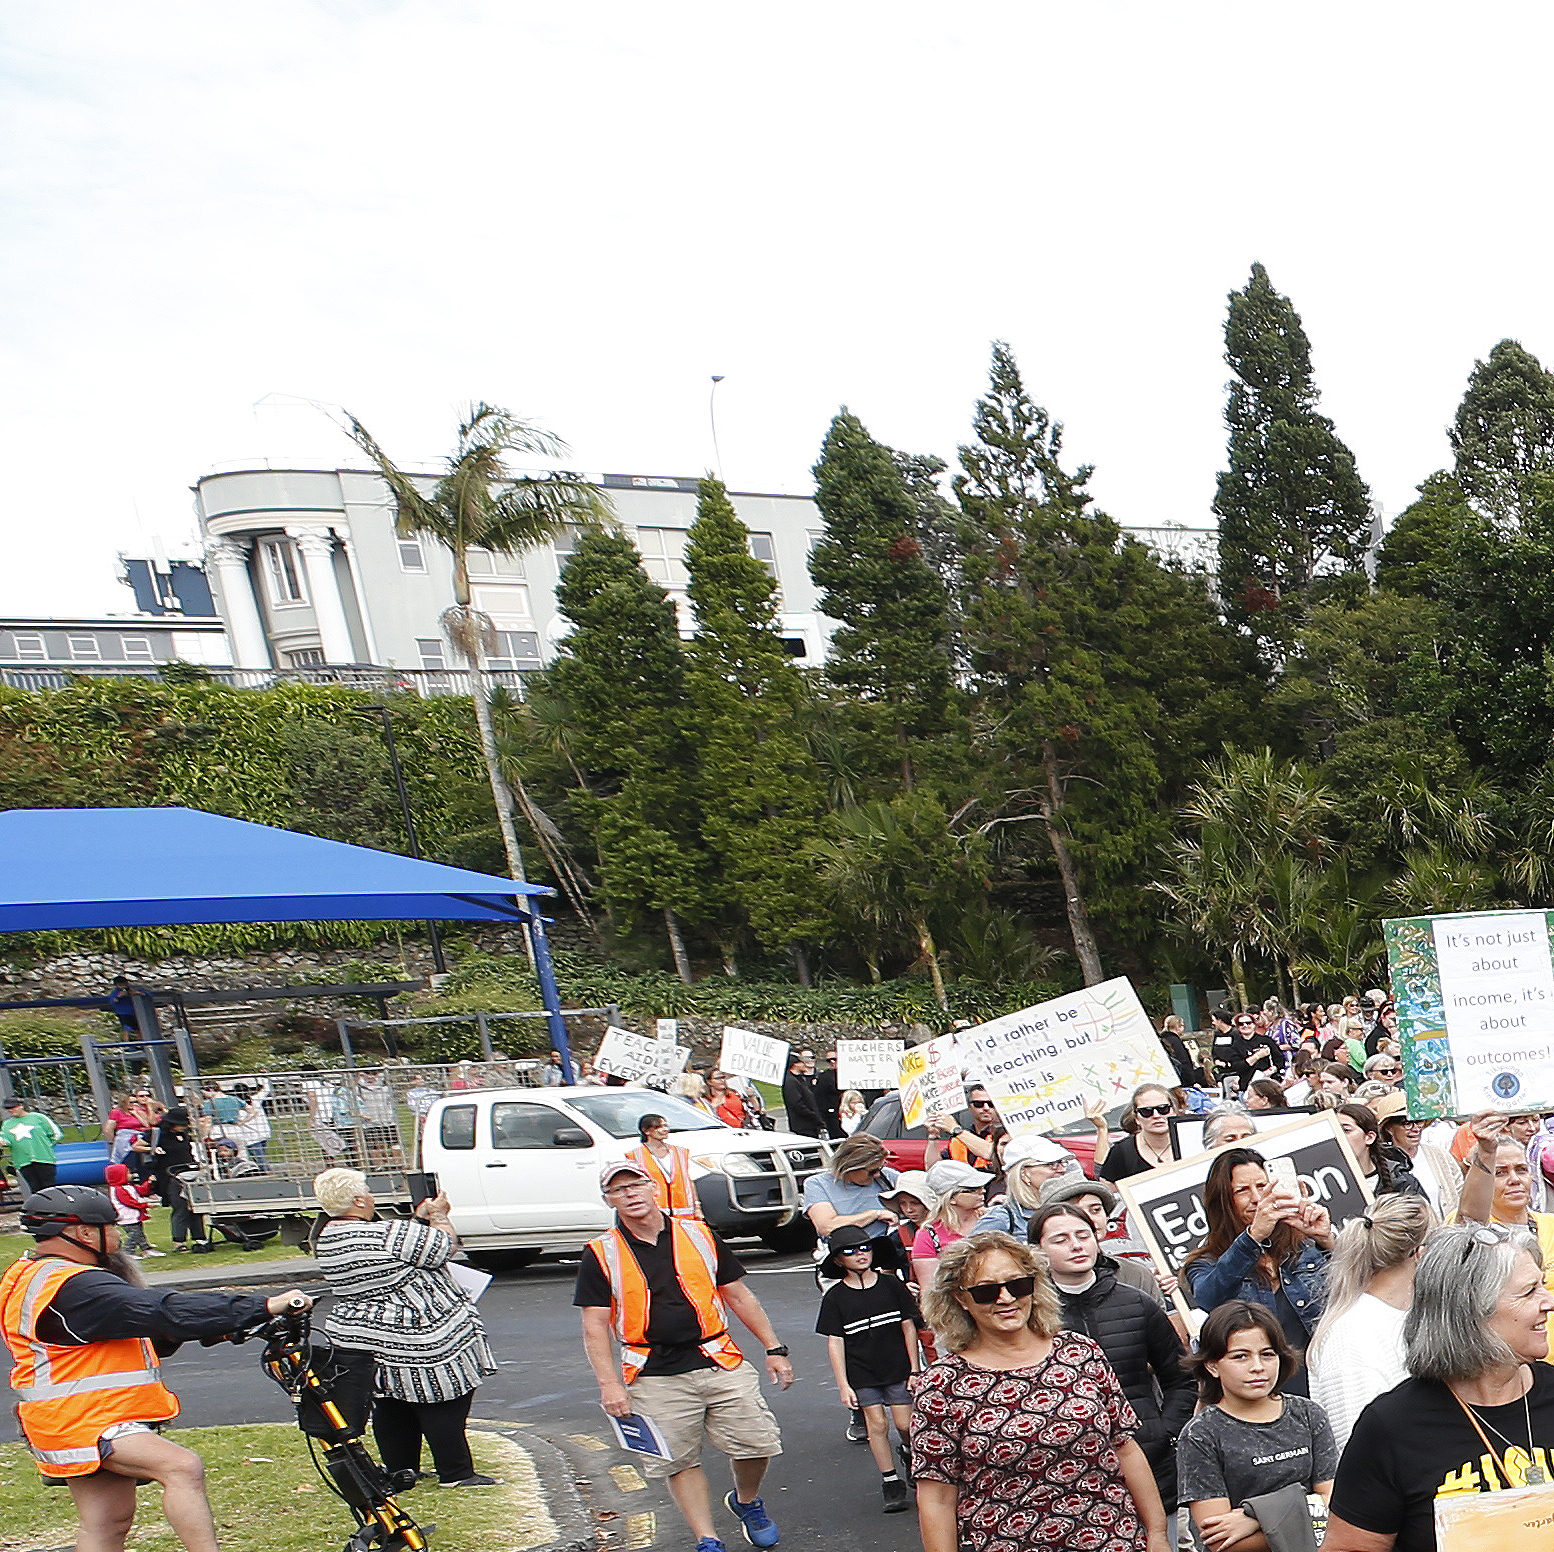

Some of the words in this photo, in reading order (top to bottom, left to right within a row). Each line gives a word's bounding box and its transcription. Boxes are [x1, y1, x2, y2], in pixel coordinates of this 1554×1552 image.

[1446, 931, 1470, 948] It's
[1475, 930, 1503, 947] not
[1505, 929, 1537, 948] just
[1471, 957, 1519, 973] about
[1453, 991, 1517, 1008] income,
[1521, 987, 1546, 1003] it's
[974, 1036, 998, 1053] I'd
[1003, 1017, 1050, 1043] rather
[1055, 1008, 1079, 1023] be
[1480, 1014, 1527, 1031] about
[743, 1034, 778, 1057] VALUE
[839, 1042, 904, 1053] TEACHERS
[985, 1043, 1063, 1076] teaching,
[1064, 1031, 1093, 1049] but
[1466, 1046, 1551, 1066] outcomes!
[598, 1057, 648, 1081] EVERY
[730, 1053, 781, 1080] EDUCATION
[848, 1054, 894, 1063] MATTER
[849, 1079, 893, 1089] MATTER
[1008, 1079, 1037, 1095] this
[1040, 1071, 1055, 1083] is
[1003, 1092, 1085, 1125] important!
